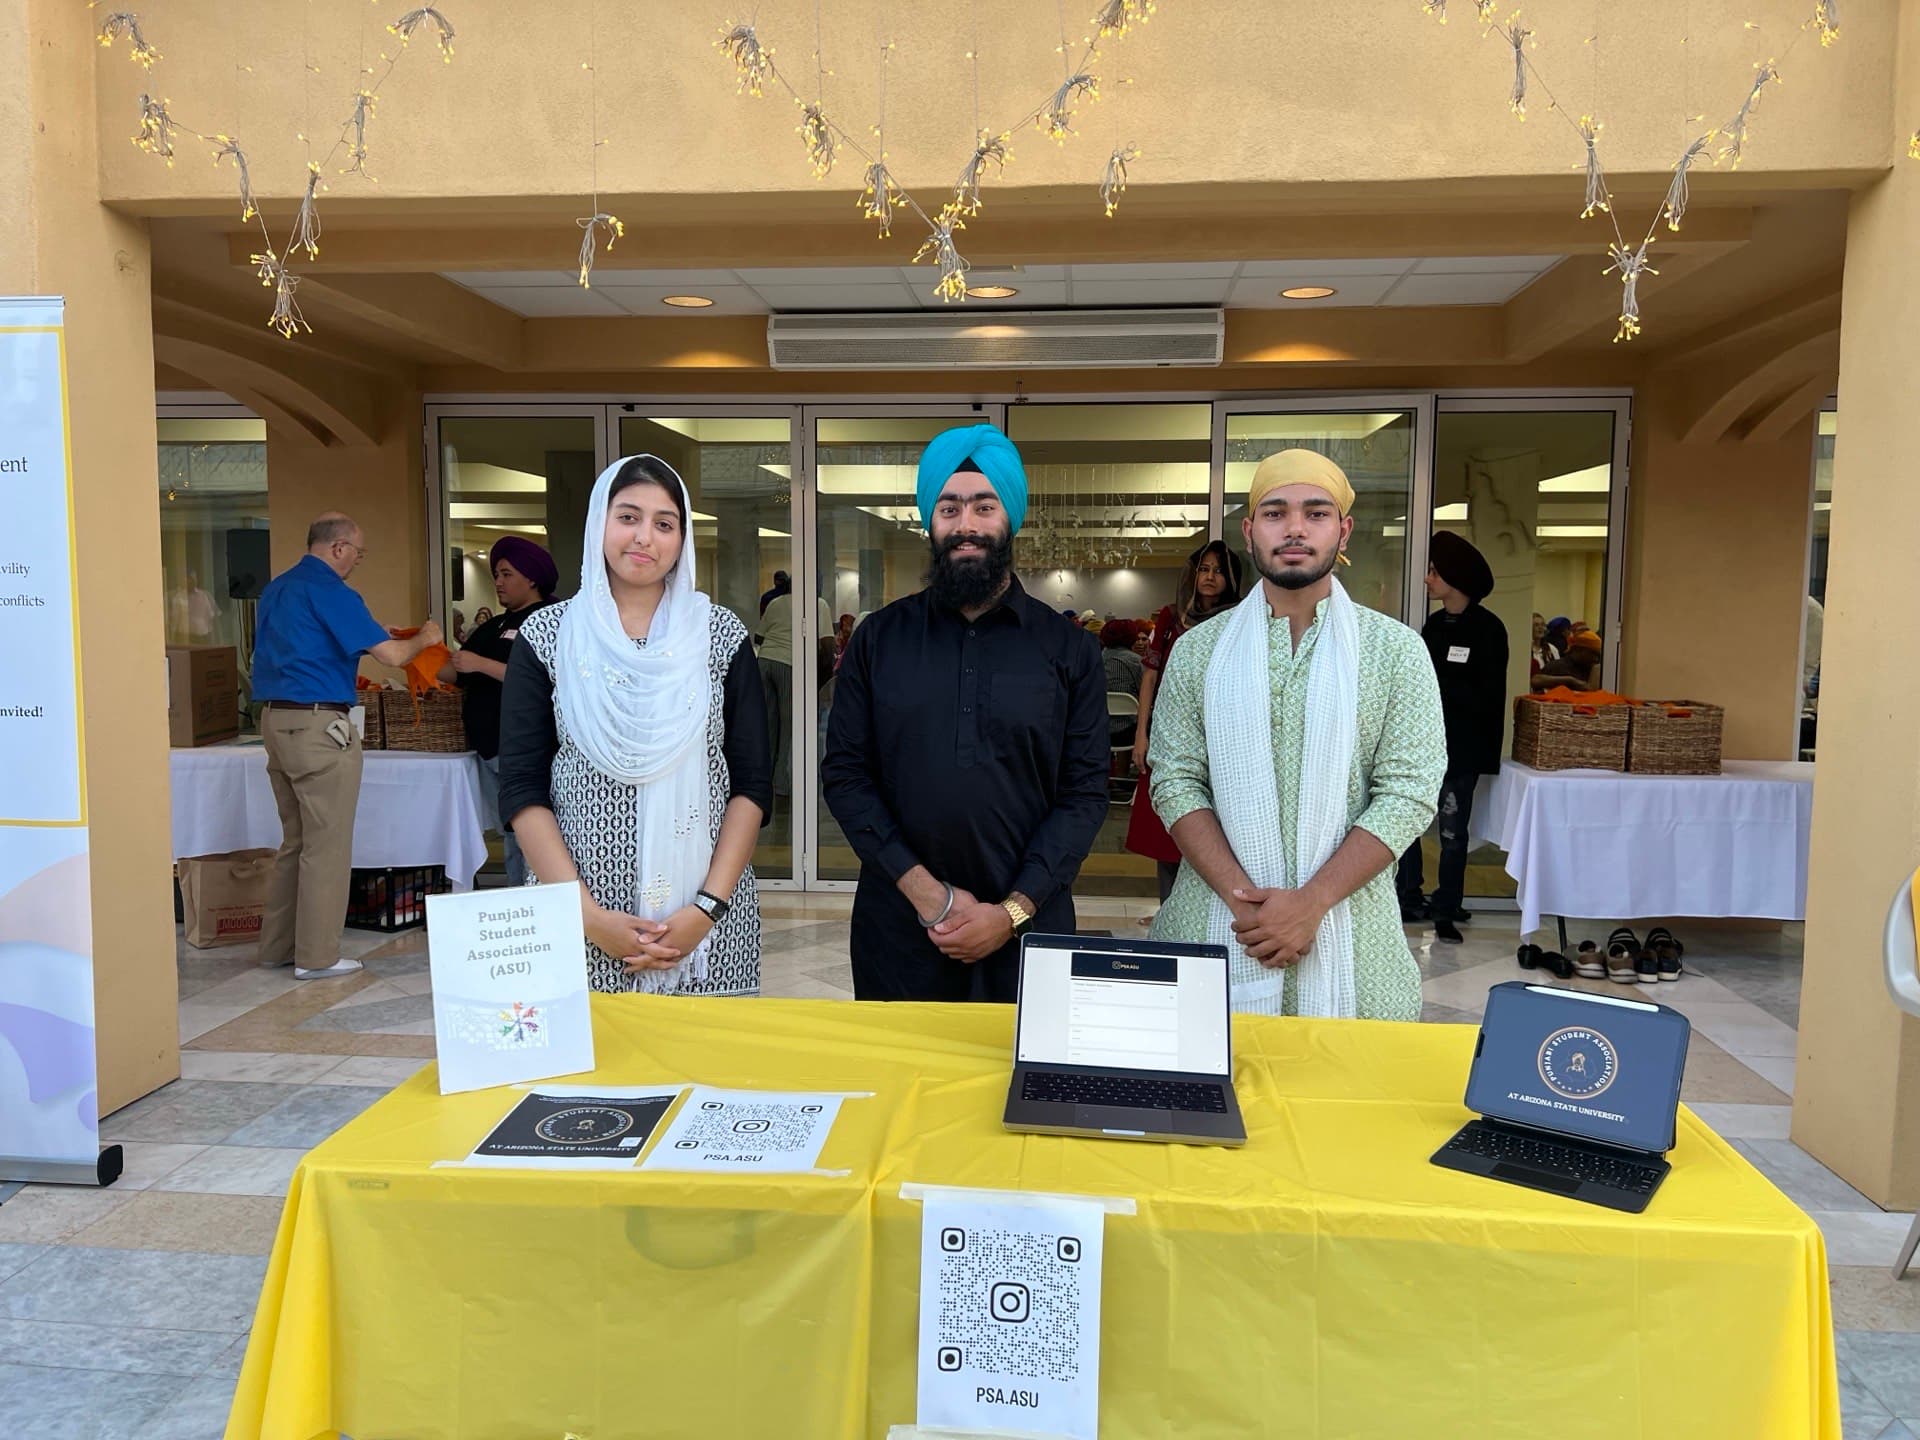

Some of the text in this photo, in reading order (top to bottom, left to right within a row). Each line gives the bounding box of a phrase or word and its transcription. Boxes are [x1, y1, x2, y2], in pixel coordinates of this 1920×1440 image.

[478, 906, 535, 923] Punjabi
[480, 925, 536, 941] Student
[467, 942, 551, 961] Association
[490, 961, 532, 980] (ASU)
[1544, 1032, 1612, 1089] PUNJABI STUDENT ASSOCIATION
[1508, 1092, 1625, 1122] AT ARIZONA STATE UNIVERSITY
[703, 1154, 763, 1162] PSA.ASU
[976, 1387, 1039, 1408] PSA.ASU
